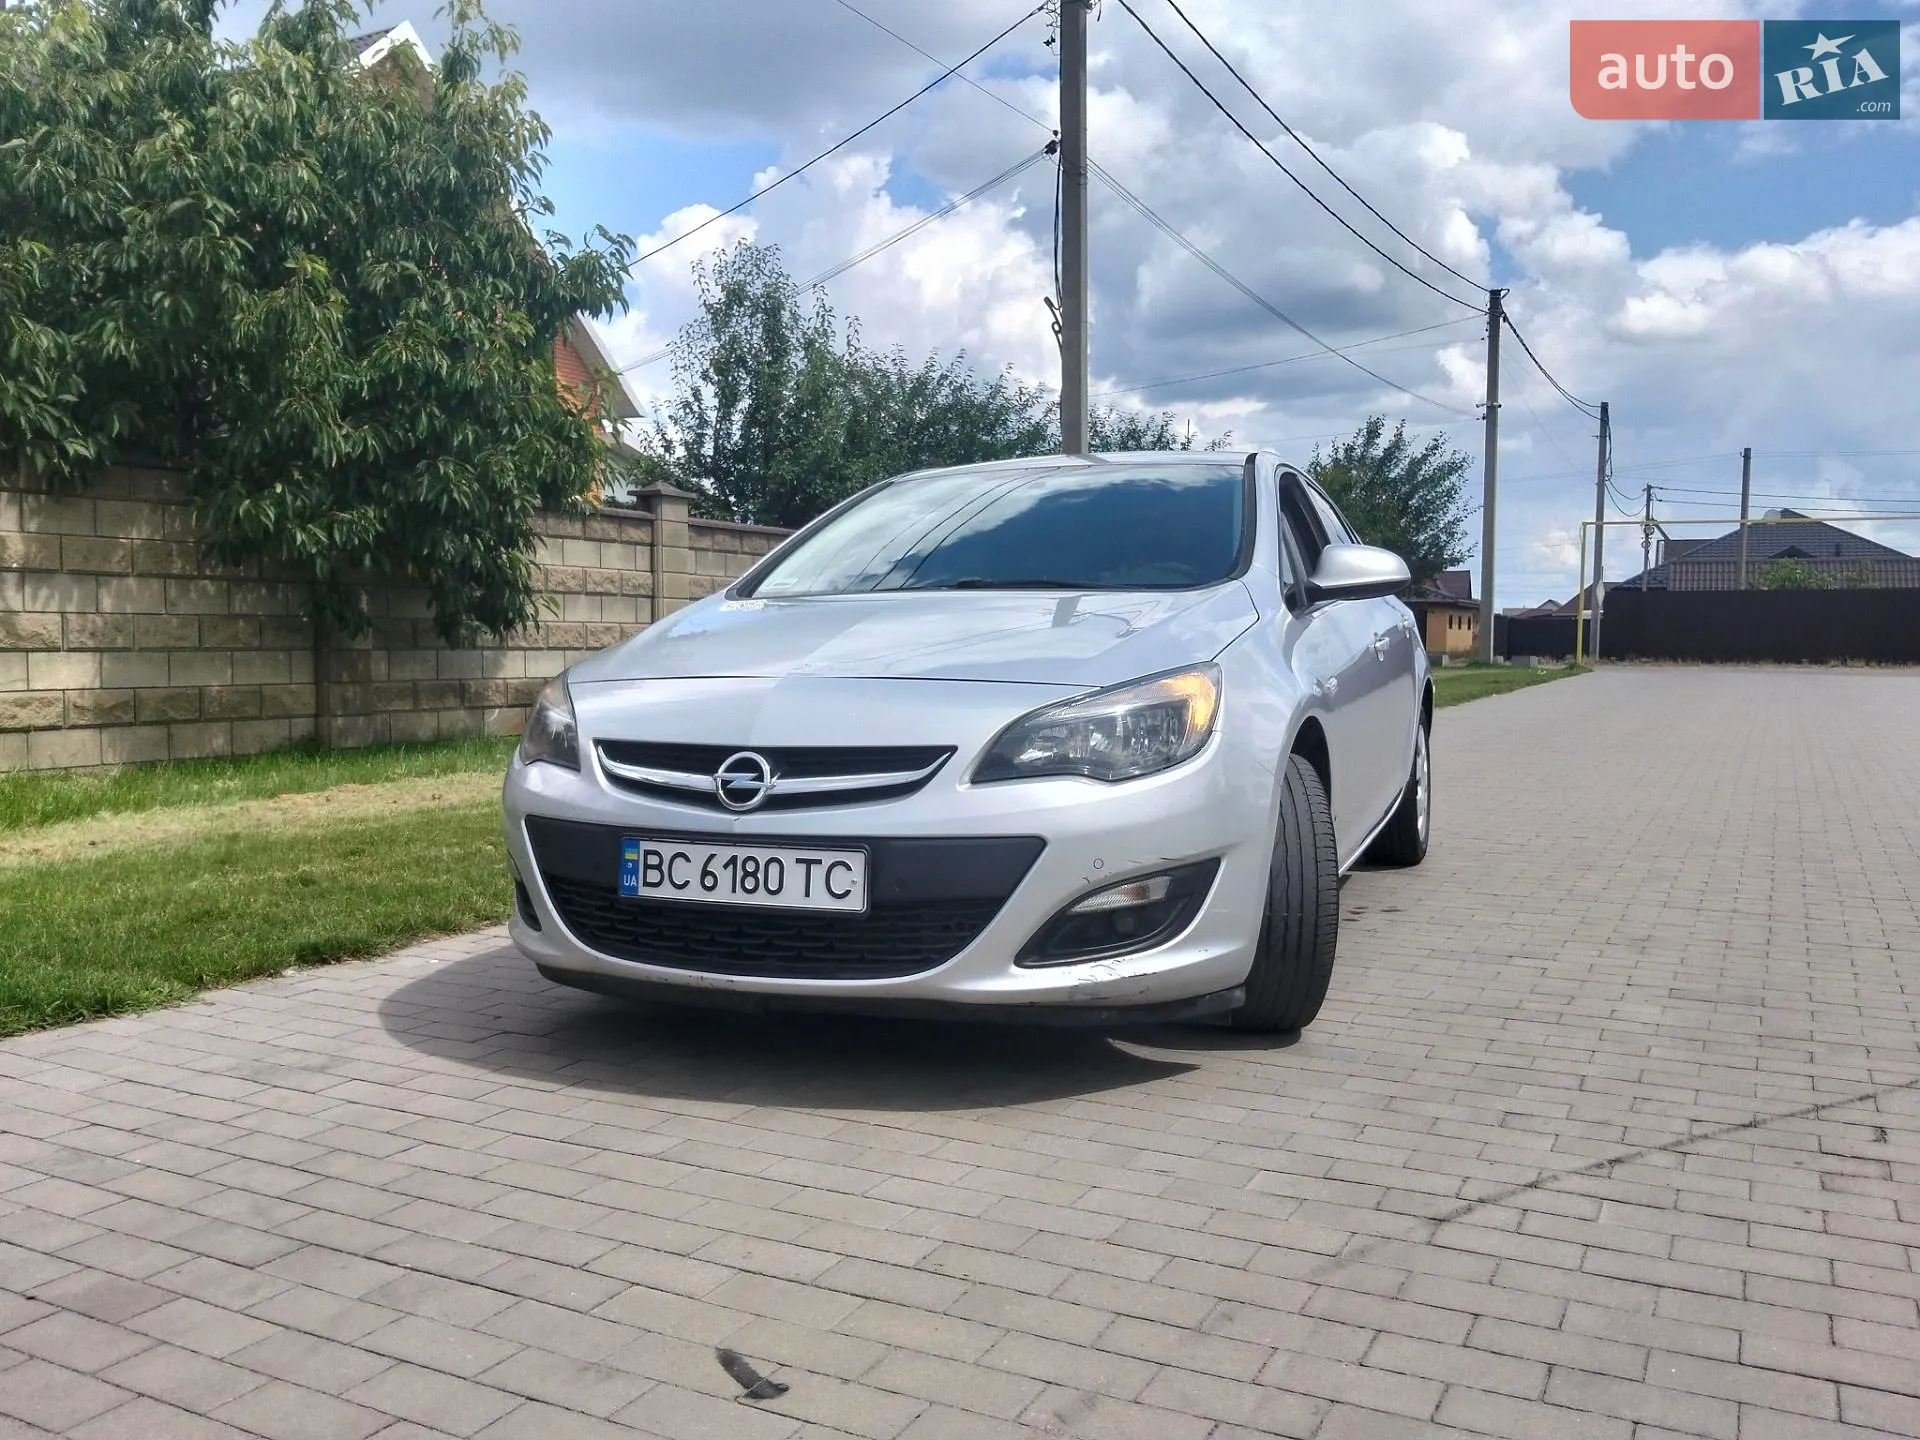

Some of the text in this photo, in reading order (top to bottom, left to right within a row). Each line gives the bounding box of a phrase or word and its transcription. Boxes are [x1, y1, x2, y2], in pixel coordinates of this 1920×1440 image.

[623, 874, 638, 887] UA
[642, 848, 853, 900] BC 6180 TC
